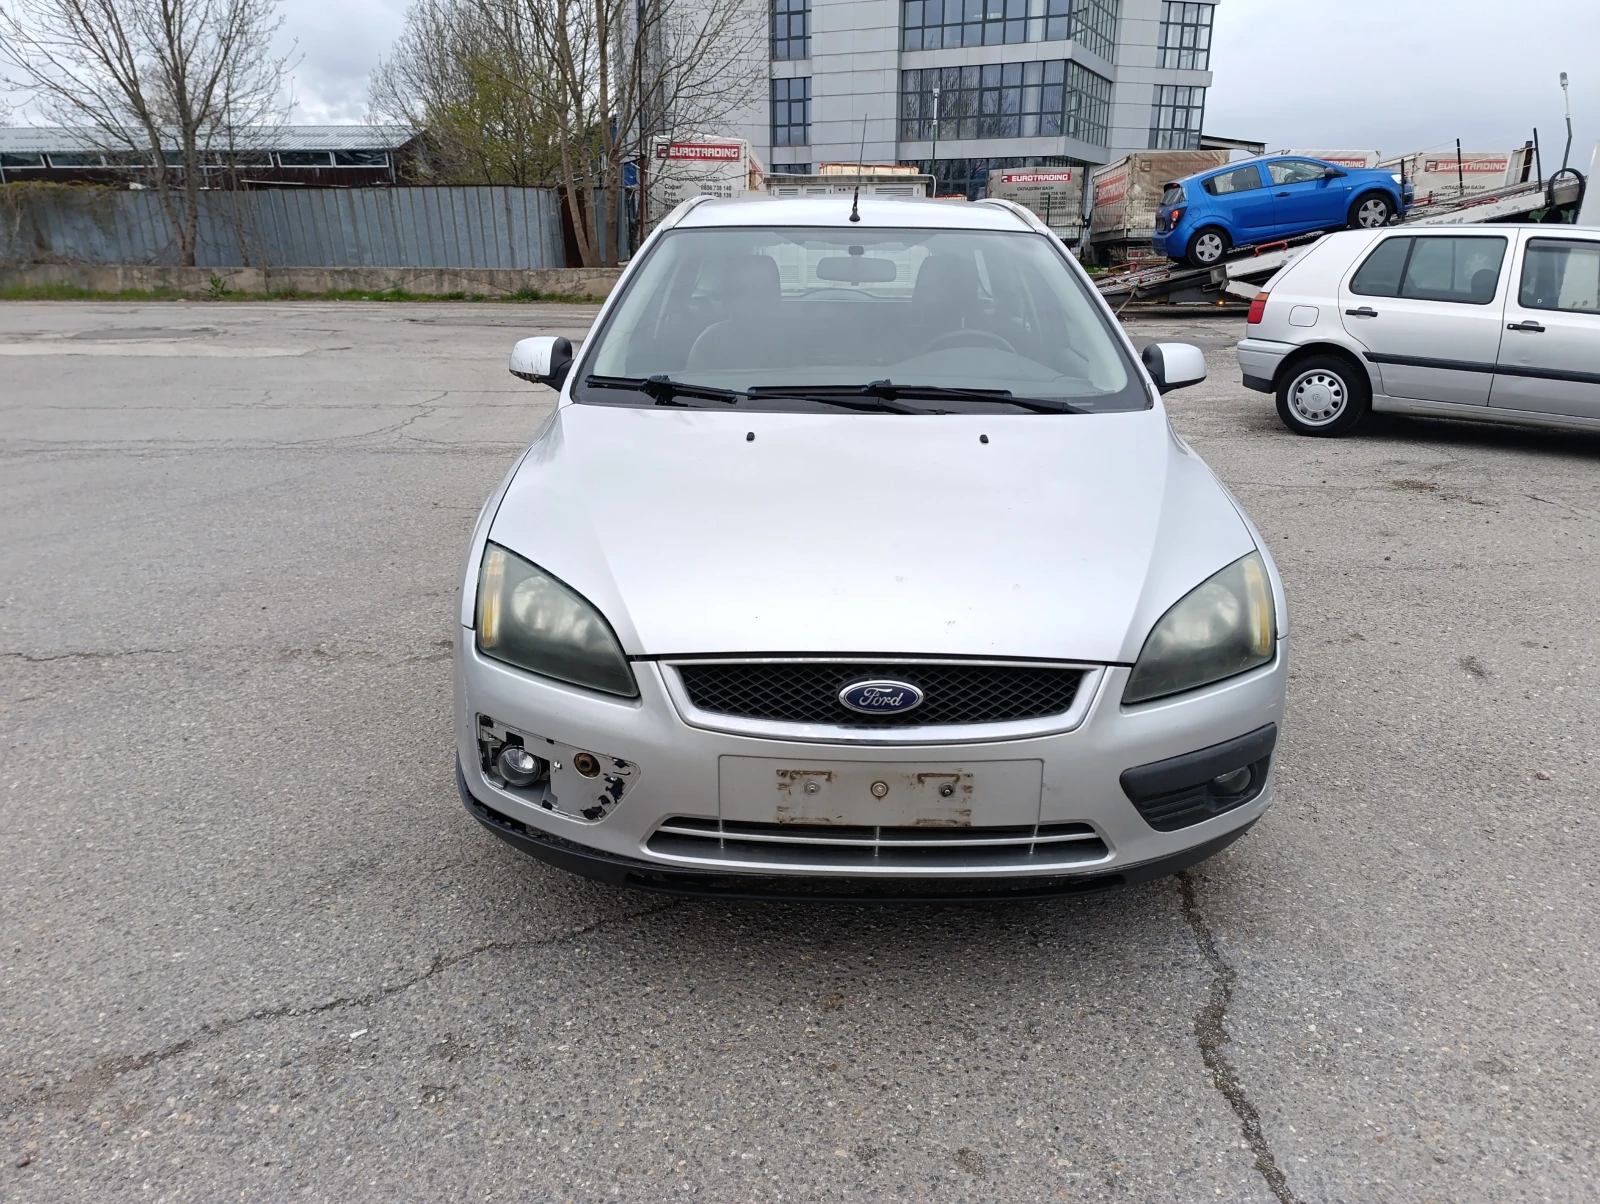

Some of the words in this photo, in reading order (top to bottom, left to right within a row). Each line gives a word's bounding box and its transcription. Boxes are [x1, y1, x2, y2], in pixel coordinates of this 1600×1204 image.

[669, 147, 739, 158] EUROTRADING
[1011, 174, 1068, 182] EUROTRADING
[859, 687, 904, 706] Ford
